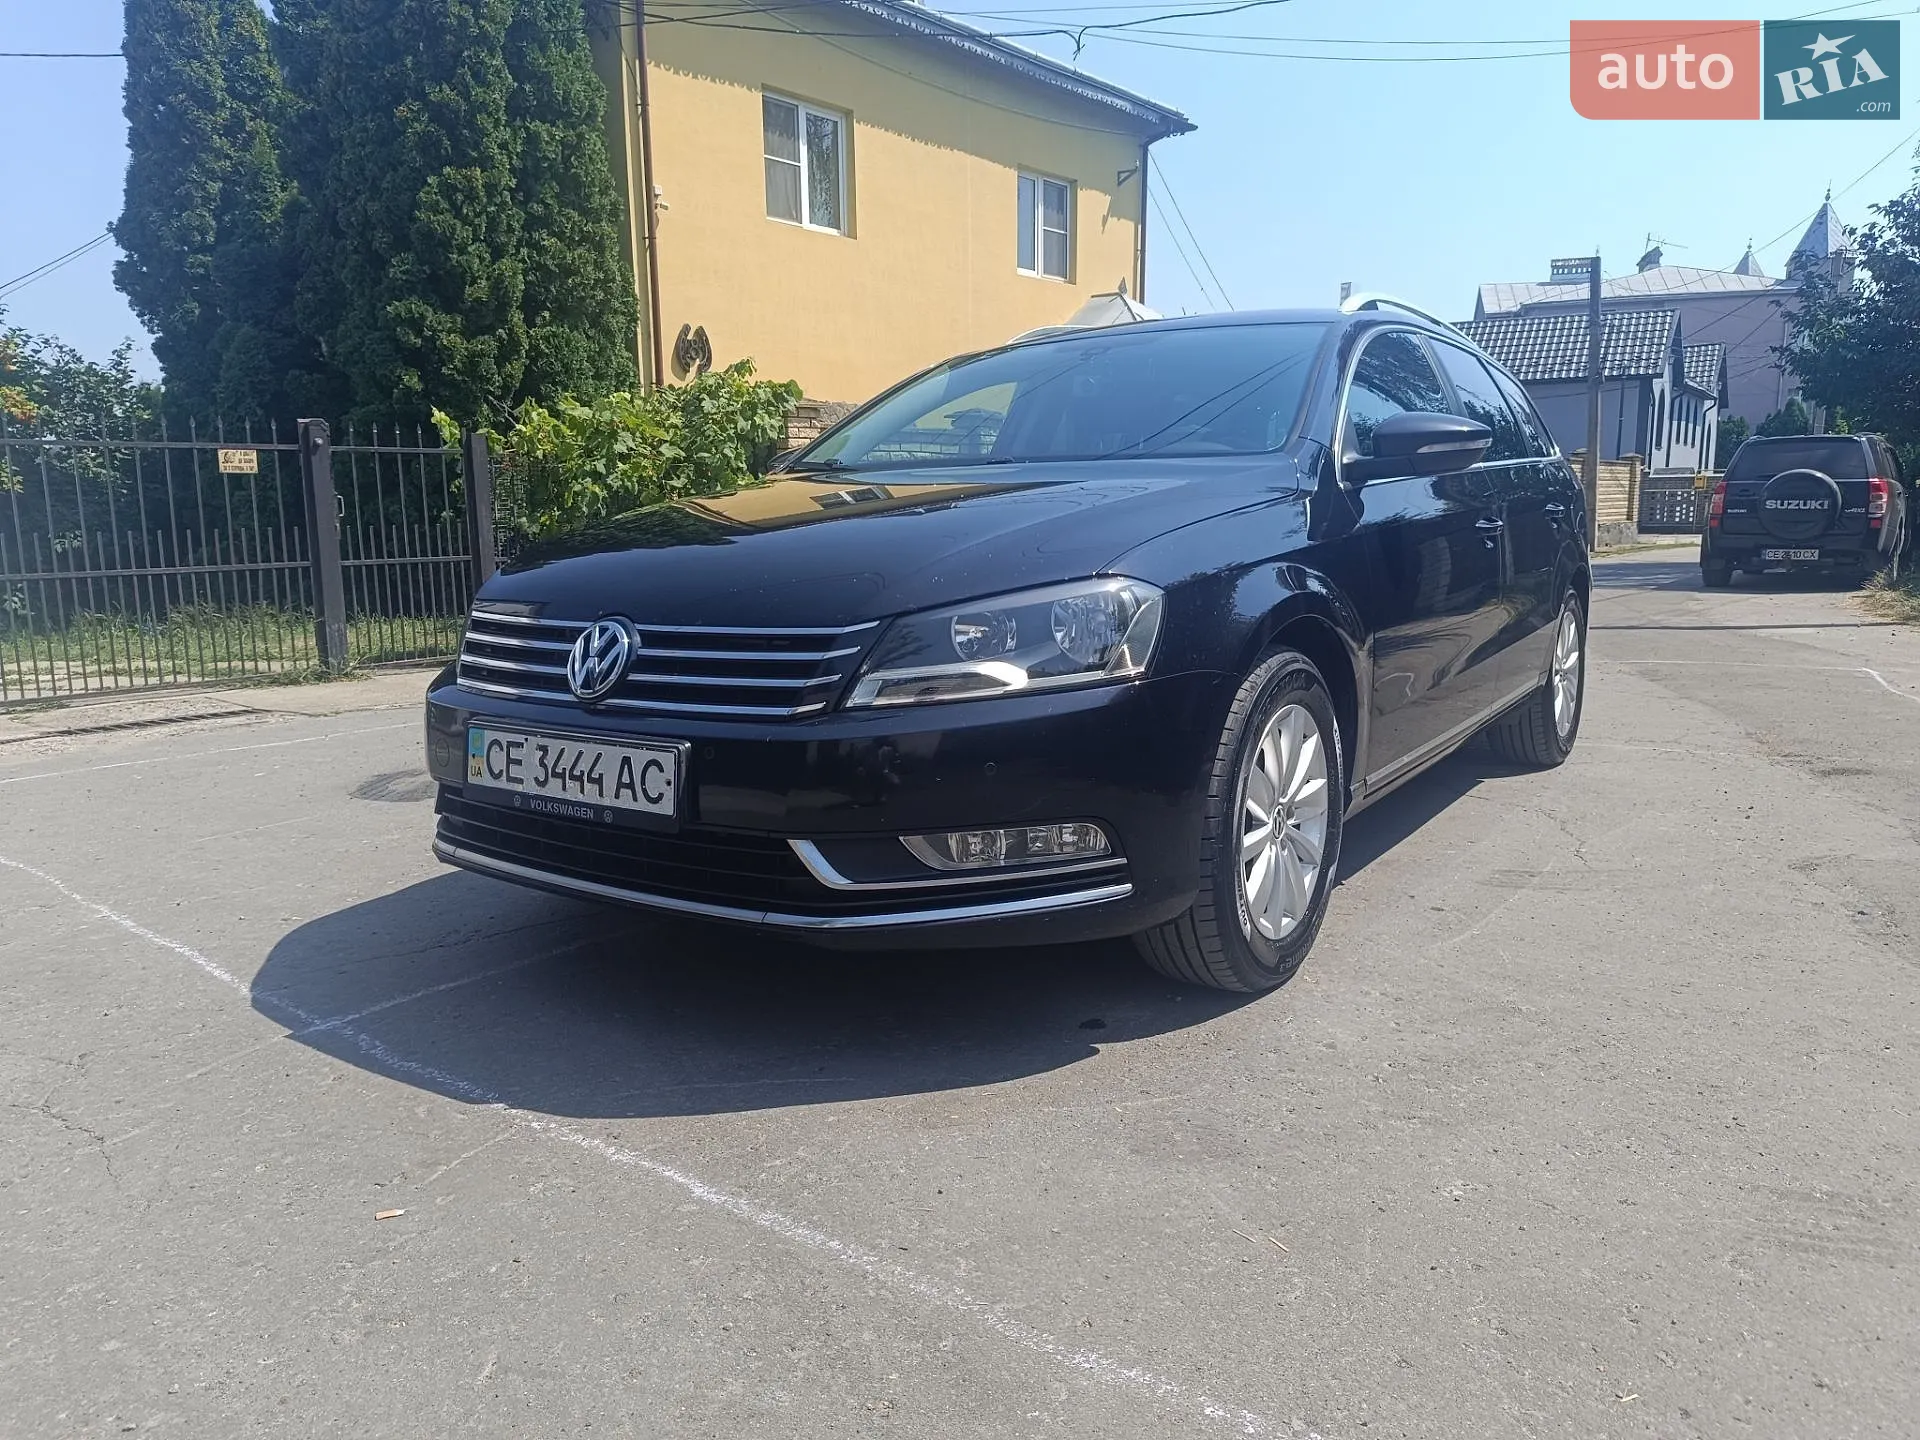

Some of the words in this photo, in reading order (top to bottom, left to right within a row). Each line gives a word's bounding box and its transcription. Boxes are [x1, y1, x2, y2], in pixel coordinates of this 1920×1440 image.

[1765, 500, 1829, 510] SUZUKI
[1767, 550, 1780, 559] CE
[471, 765, 483, 779] UA
[486, 738, 525, 785] CE
[533, 743, 604, 798] 3444
[614, 755, 665, 804] AC
[530, 799, 594, 819] VOLKSWAGEN
